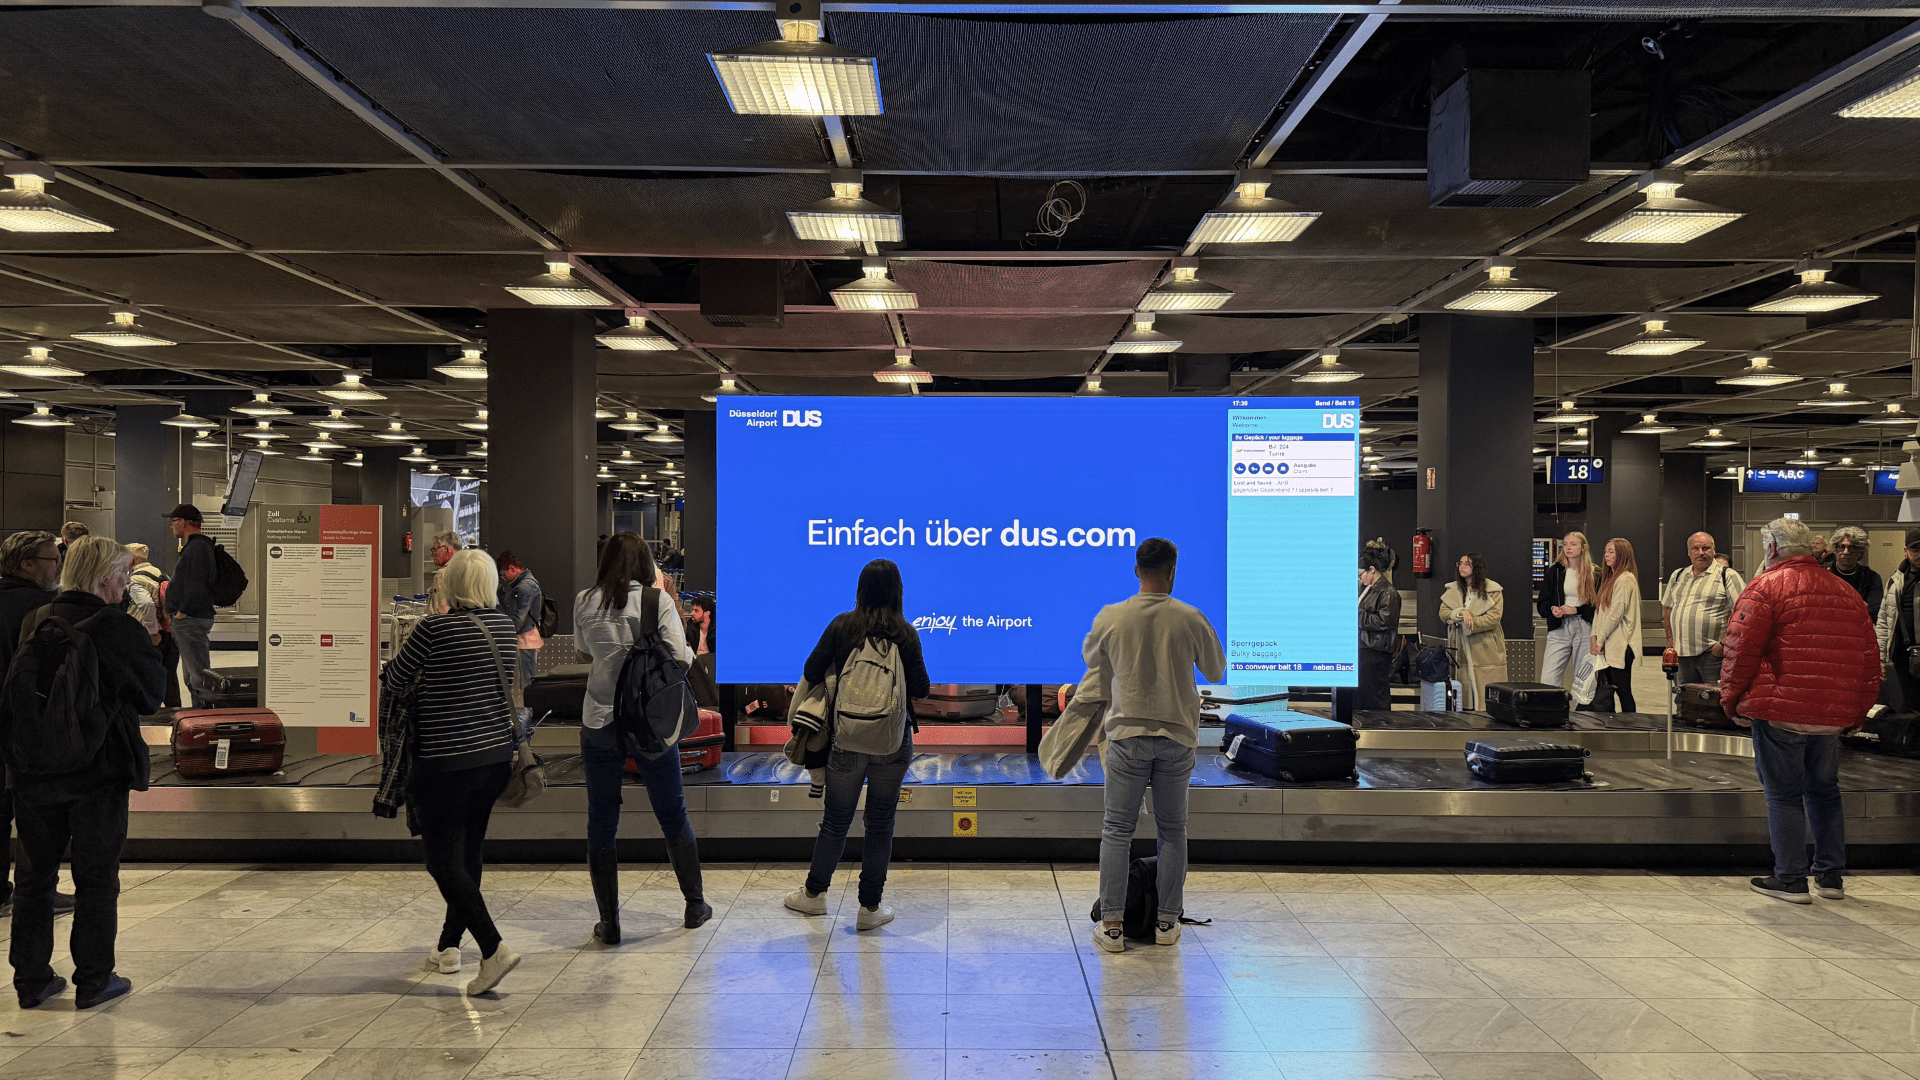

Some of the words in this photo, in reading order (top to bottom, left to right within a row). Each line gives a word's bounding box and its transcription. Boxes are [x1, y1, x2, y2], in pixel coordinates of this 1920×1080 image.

[729, 409, 778, 418] Düsseldorf
[782, 410, 822, 427] DUS
[1323, 413, 1354, 428] DUS
[746, 419, 778, 428] Airport
[1568, 465, 1588, 479] 18
[1777, 470, 1804, 480] A,B,C
[808, 519, 915, 546] Einfach
[926, 519, 992, 546] über
[1000, 519, 1136, 547] dus.com
[912, 612, 957, 635] enjoy
[962, 615, 983, 627] the
[986, 615, 1033, 630] Airport
[1252, 650, 1282, 658] baggage
